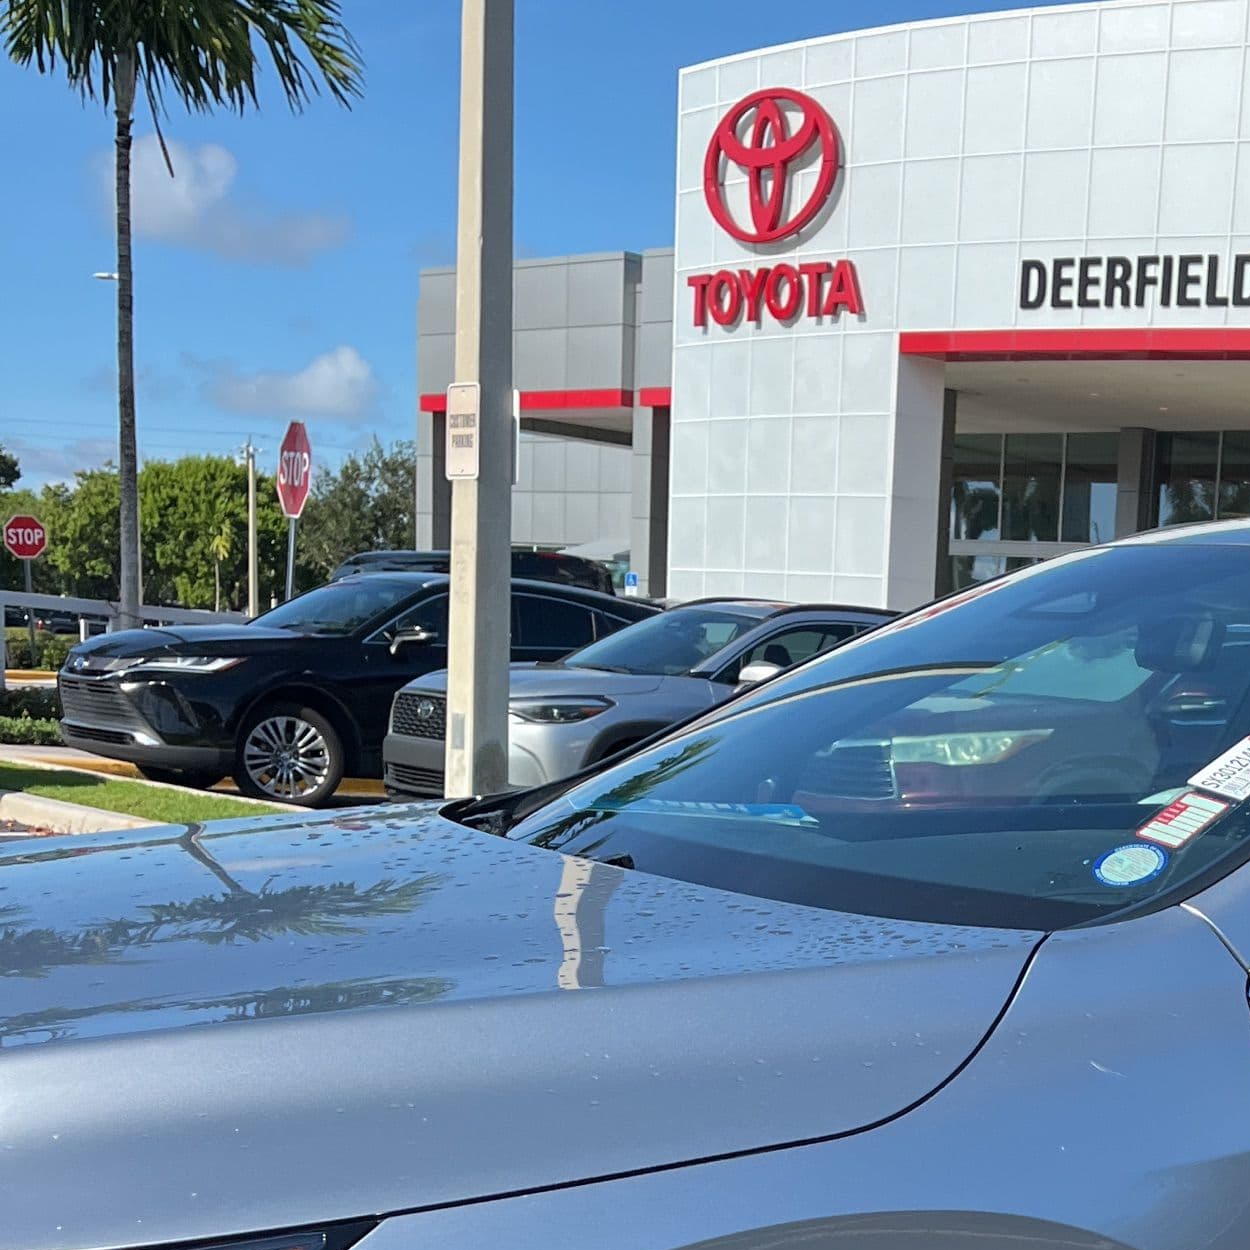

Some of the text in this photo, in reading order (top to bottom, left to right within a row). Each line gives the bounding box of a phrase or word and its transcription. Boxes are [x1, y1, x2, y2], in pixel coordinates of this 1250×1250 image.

[687, 259, 864, 327] TOYOTA
[280, 450, 309, 487] STOP
[7, 528, 43, 545] STOP
